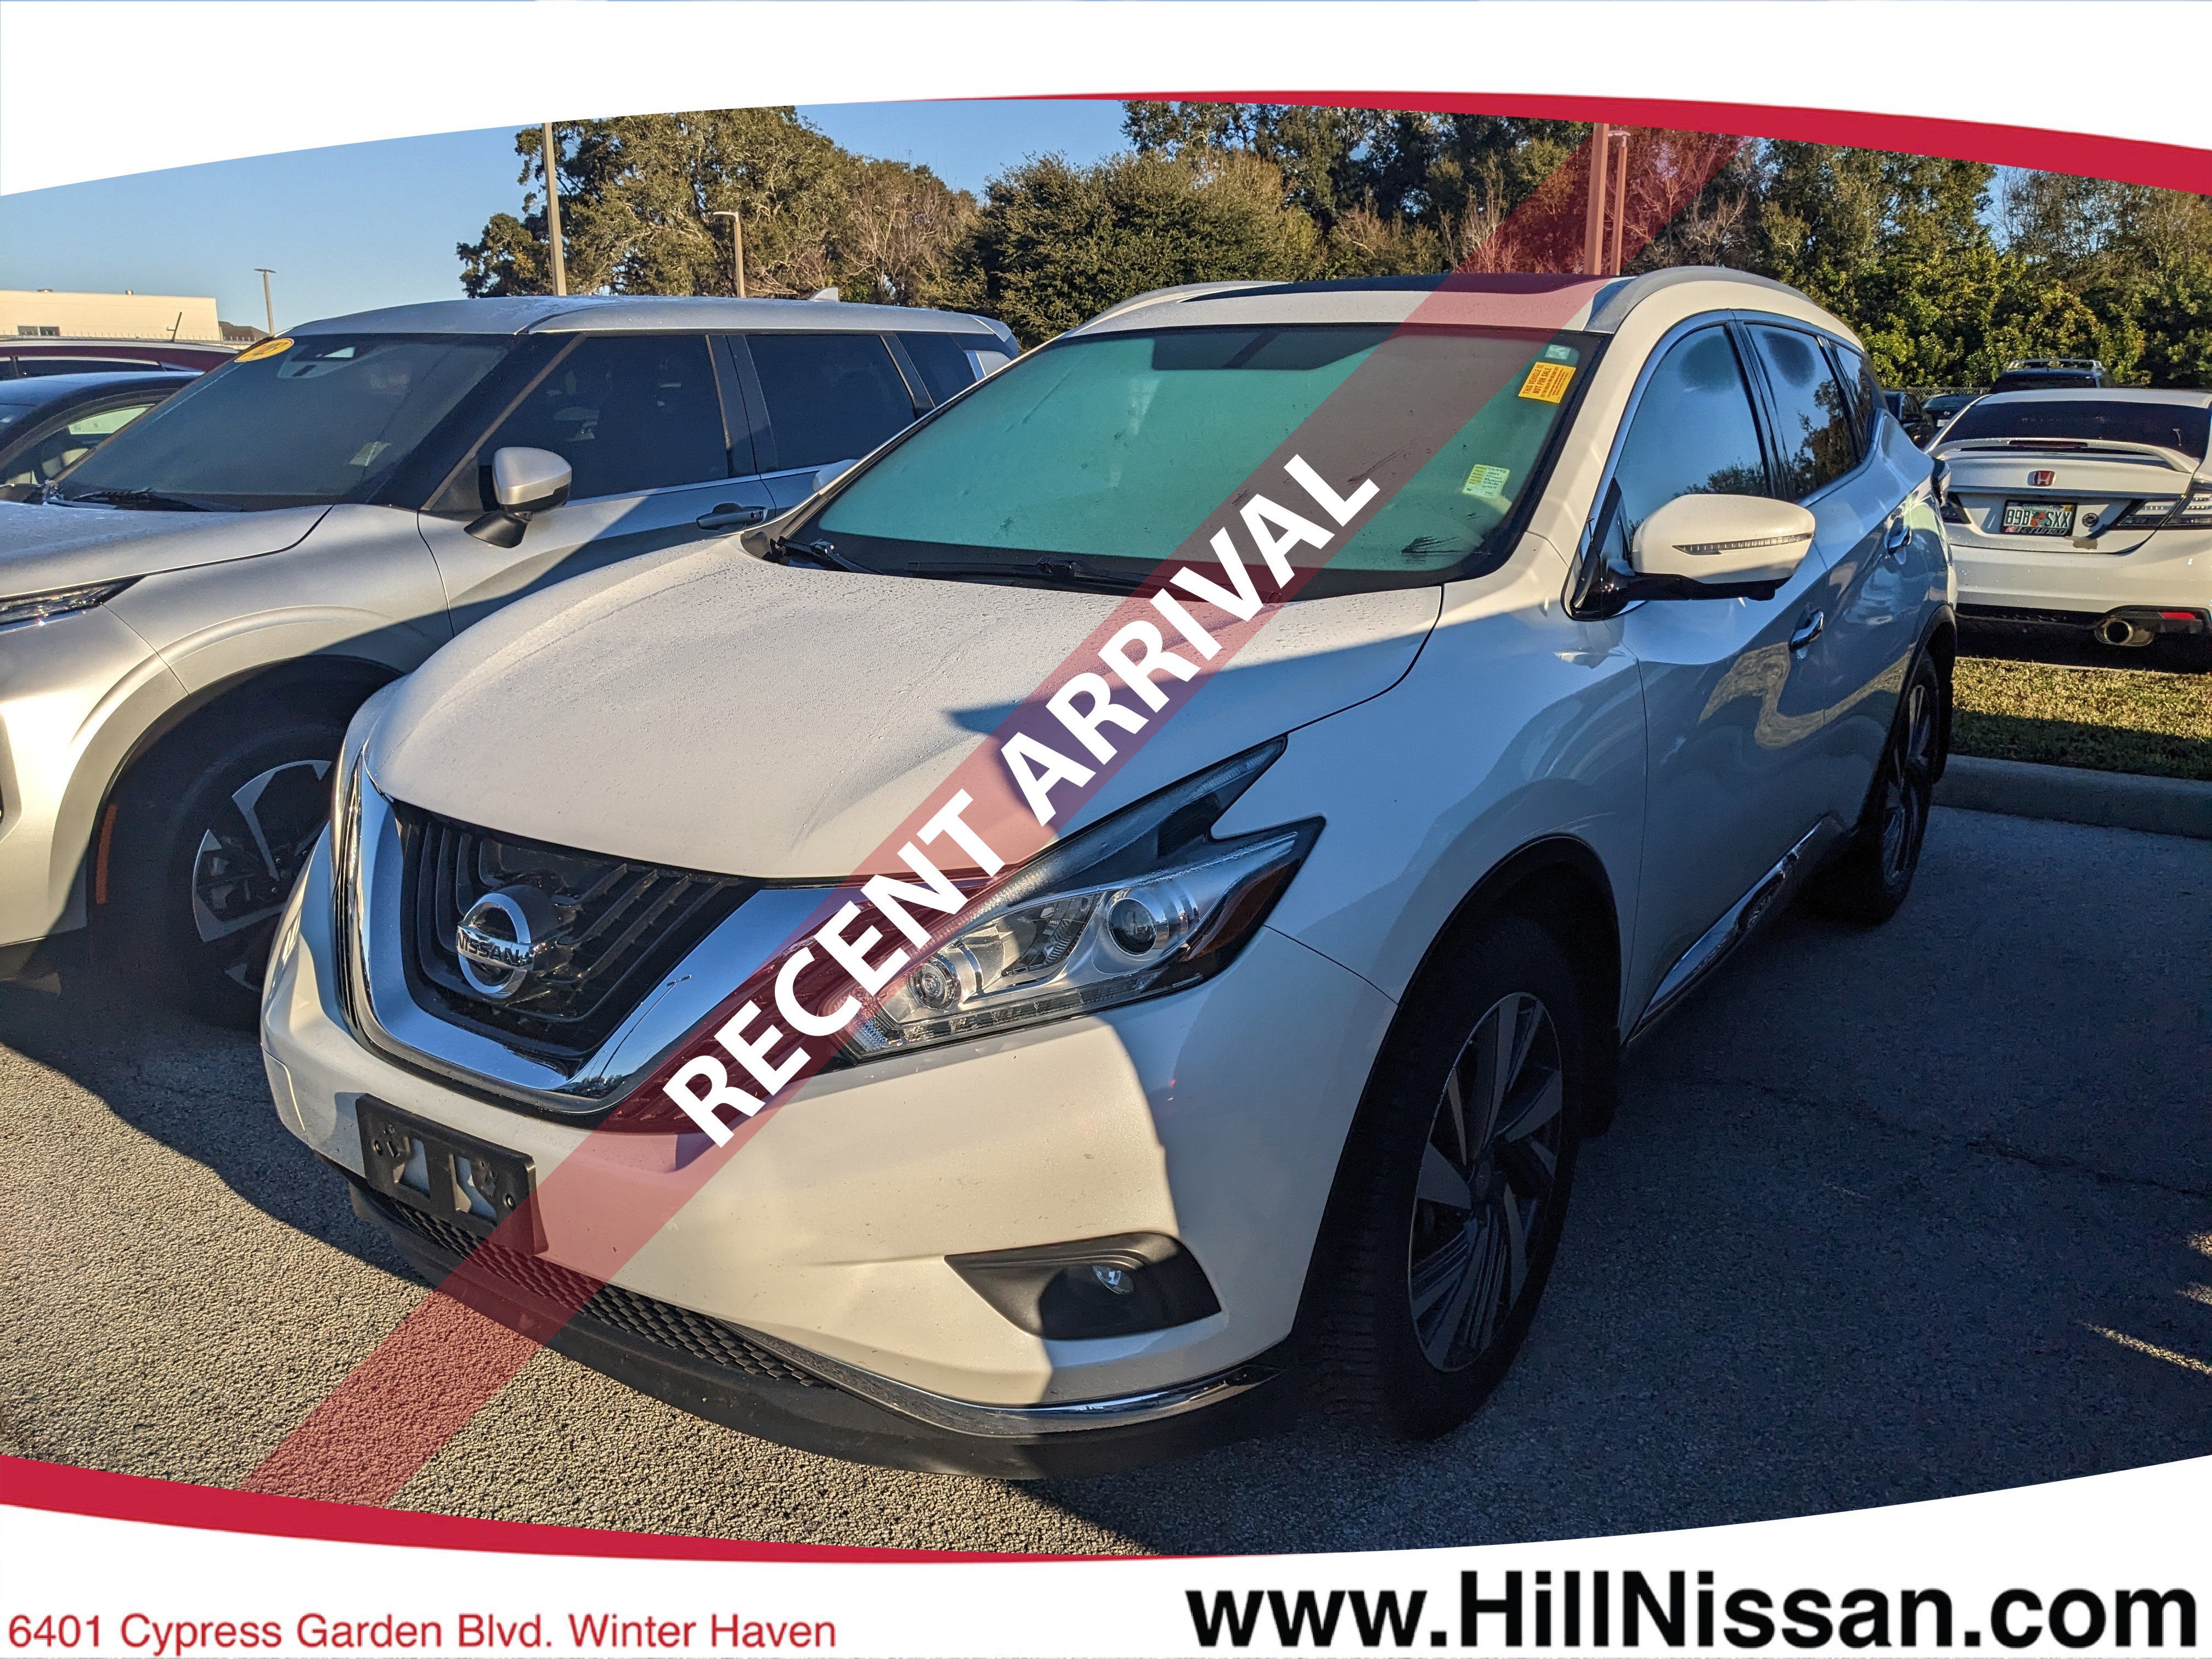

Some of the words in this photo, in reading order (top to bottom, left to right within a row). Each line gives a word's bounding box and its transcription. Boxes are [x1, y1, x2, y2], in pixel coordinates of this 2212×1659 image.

[1541, 368, 1551, 377] SALE
[1523, 385, 1533, 393] THIS
[456, 932, 521, 964] NISSAN
